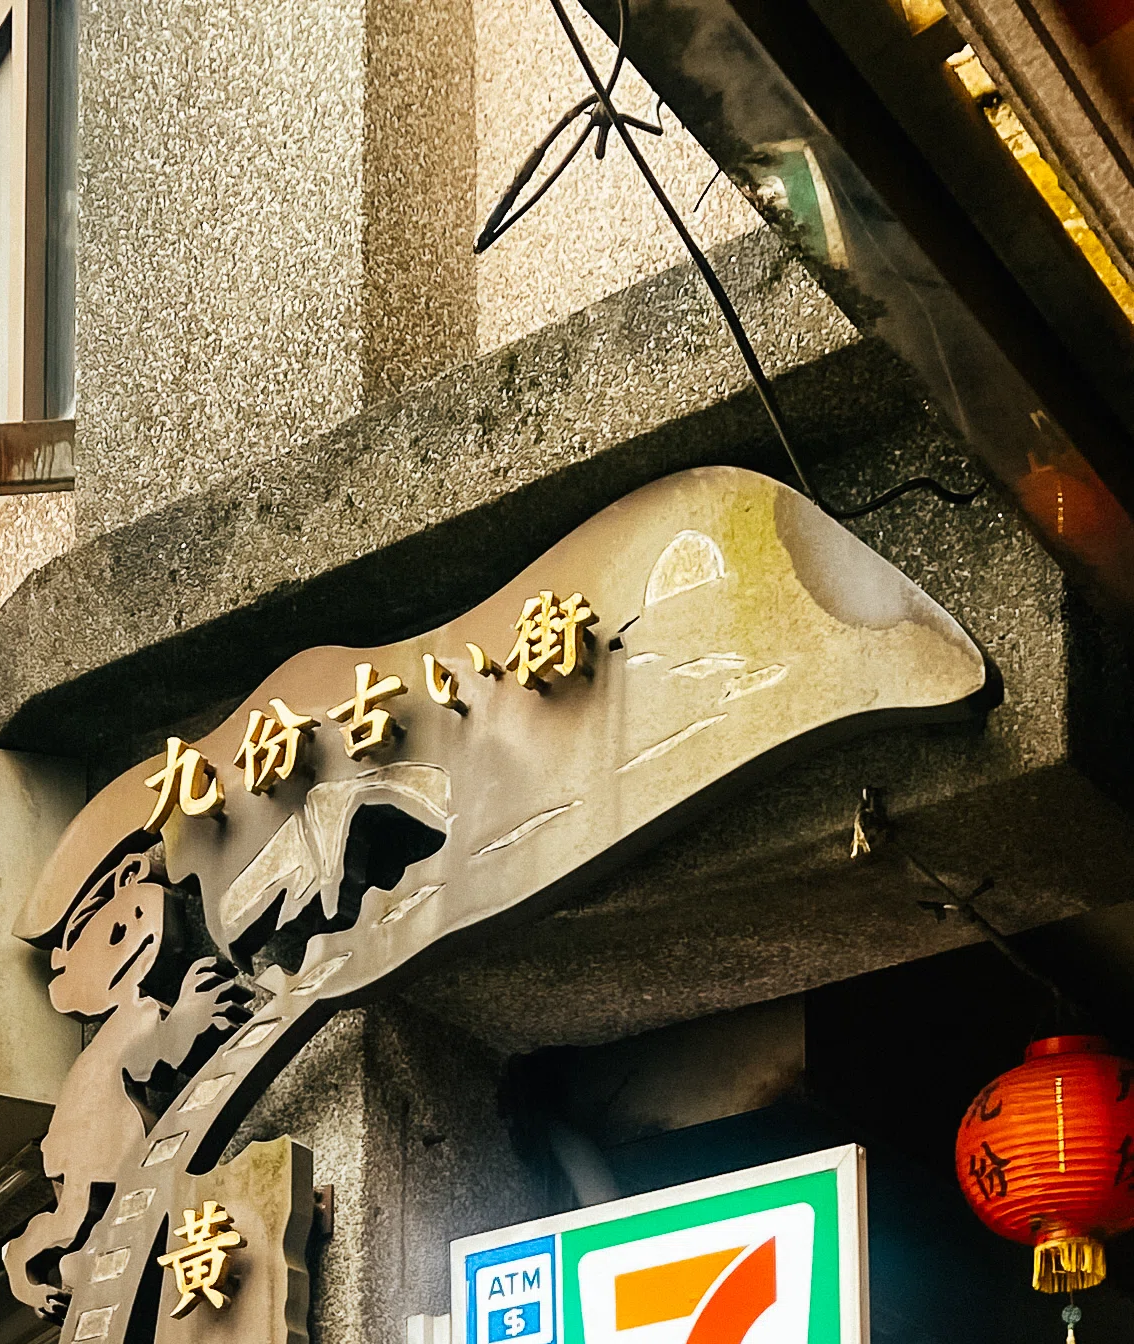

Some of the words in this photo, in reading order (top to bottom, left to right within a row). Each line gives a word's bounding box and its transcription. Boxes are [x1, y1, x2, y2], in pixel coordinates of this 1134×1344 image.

[144, 591, 599, 832] 九份古い街
[488, 1267, 541, 1300] ATM
